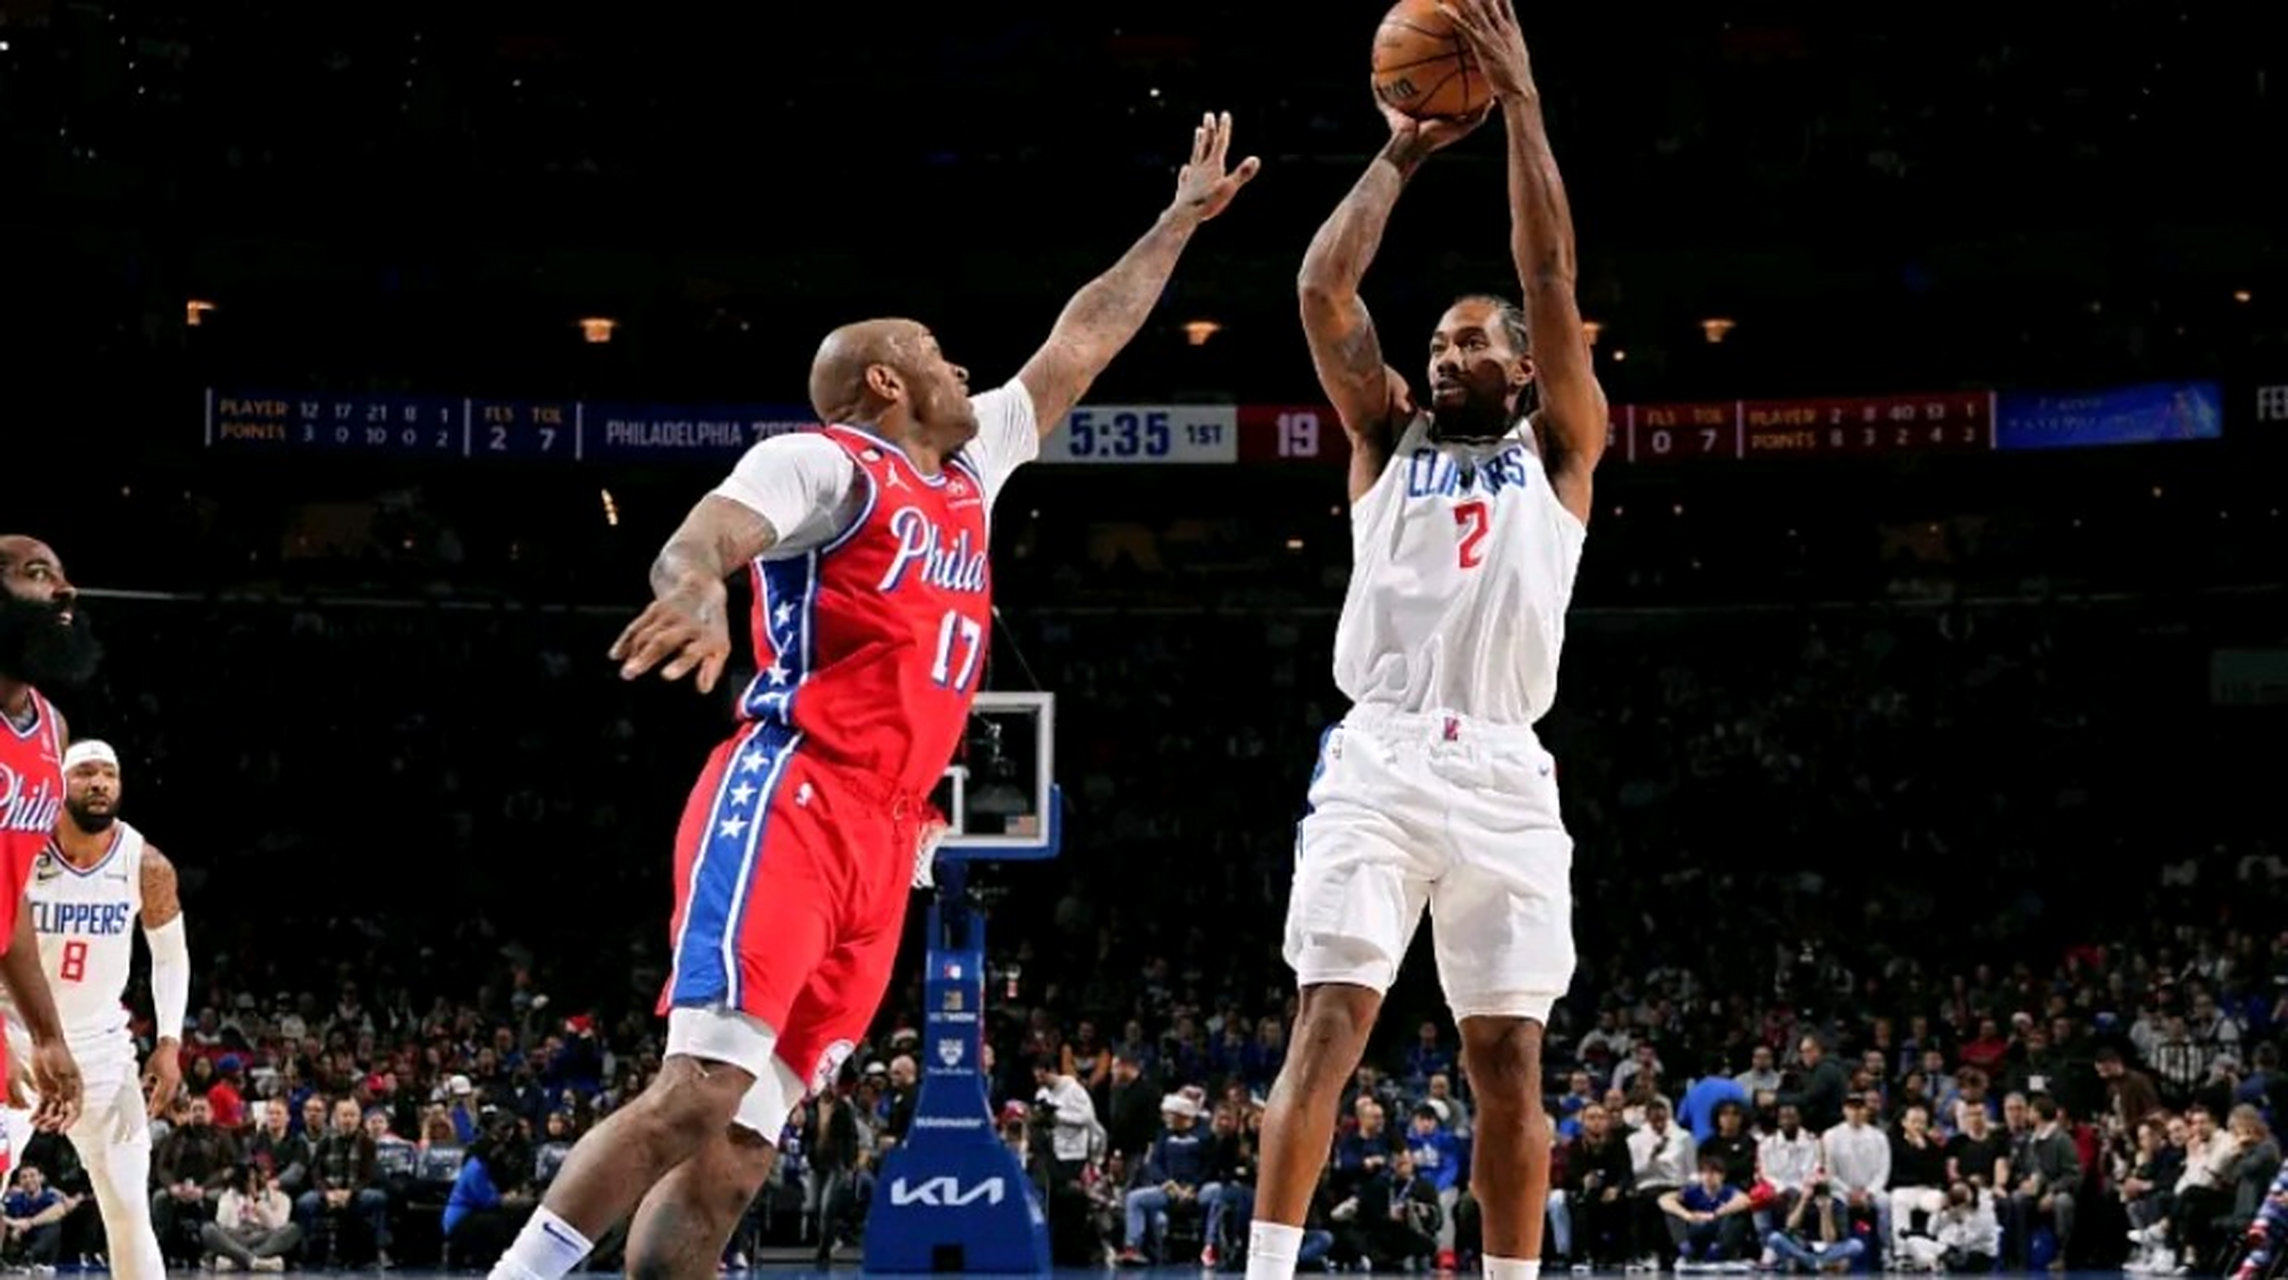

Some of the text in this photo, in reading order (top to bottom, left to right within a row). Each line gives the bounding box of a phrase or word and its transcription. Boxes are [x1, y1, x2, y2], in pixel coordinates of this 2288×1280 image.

[219, 398, 289, 417] PLAYER
[301, 401, 320, 420] 12
[366, 403, 387, 422] 21
[439, 406, 449, 424] 1
[1749, 407, 1817, 427] PLAYER
[1889, 403, 1917, 422] 40
[2257, 385, 2288, 422] FE
[219, 421, 449, 448] POINTS 3 0 10 0 2
[488, 425, 557, 451] 2 7
[605, 419, 743, 447] PHILADELPHIA
[1069, 413, 1223, 455] 5:35 1ST
[1276, 412, 1320, 457] 19
[1651, 427, 1719, 454] 0 7
[1751, 430, 1817, 449] POINTS
[1928, 425, 1944, 444] 4
[877, 506, 985, 592] Phila
[1453, 501, 1488, 569] 2
[931, 609, 982, 693] 17
[61, 941, 88, 982] 8
[891, 1177, 1004, 1206] KIA
